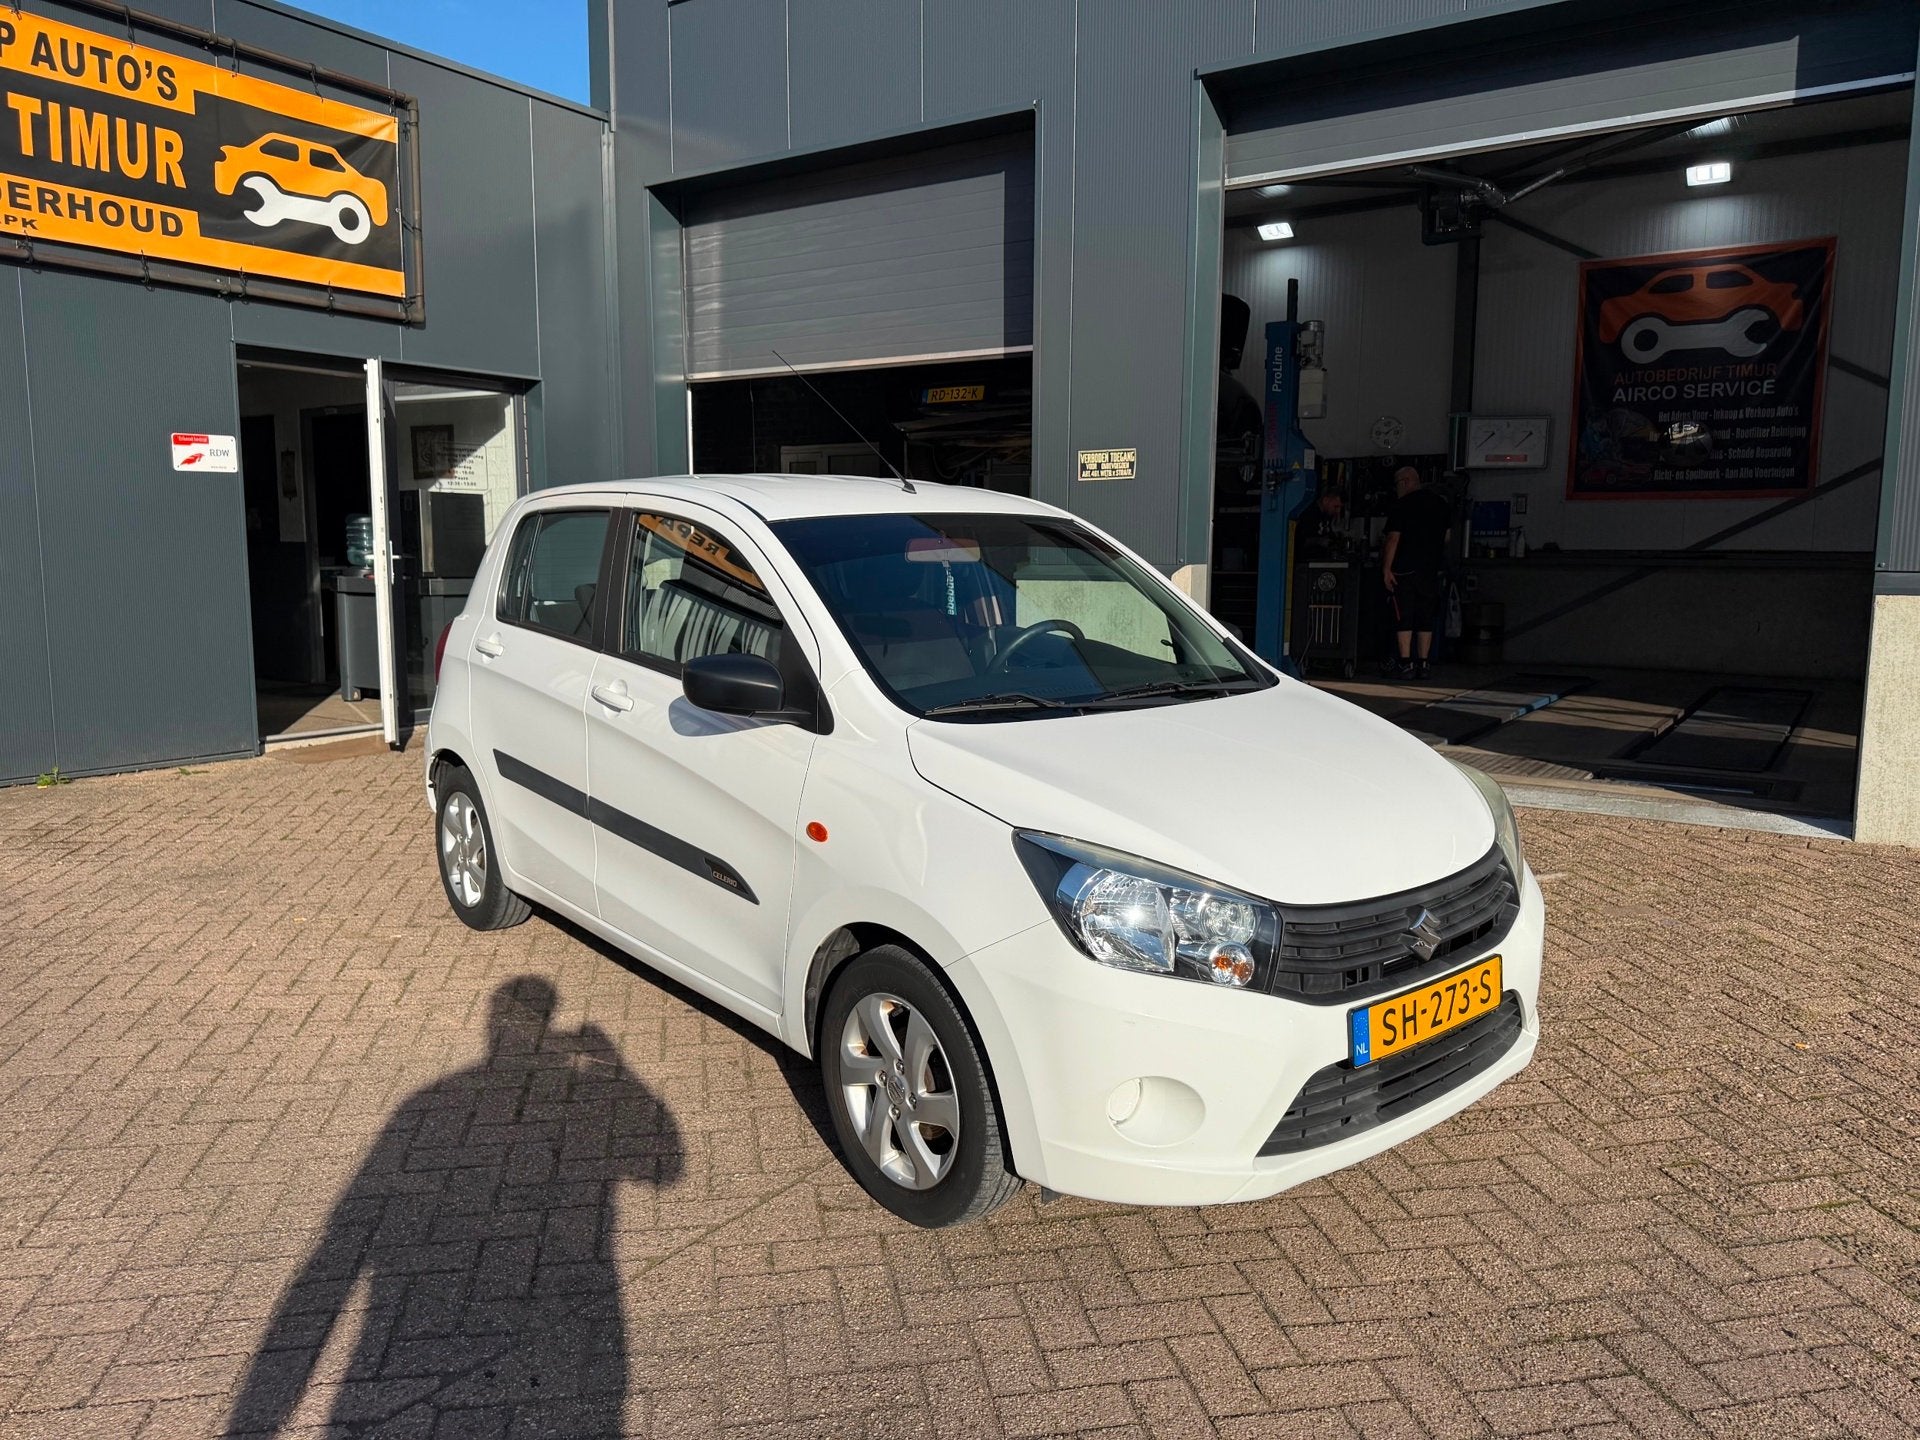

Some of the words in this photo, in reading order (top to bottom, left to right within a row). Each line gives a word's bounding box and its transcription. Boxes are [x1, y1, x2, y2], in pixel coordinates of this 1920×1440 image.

[30, 31, 178, 101] AUTO'S
[7, 92, 187, 189] TIMUR
[0, 180, 184, 238] ERHOUD
[0, 214, 39, 231] PK
[1271, 346, 1283, 392] ProLine
[1614, 366, 1723, 386] AUTOBEDRIJF
[1727, 362, 1777, 379] TIMUR
[931, 388, 979, 401] RD-132-K
[1612, 385, 1677, 402] AIRCO
[1683, 379, 1776, 399] SERVICE
[209, 448, 229, 457] RDW
[712, 870, 738, 888] CELERIO
[1382, 969, 1492, 1046] SH-273-S
[1355, 1042, 1369, 1056] NL
